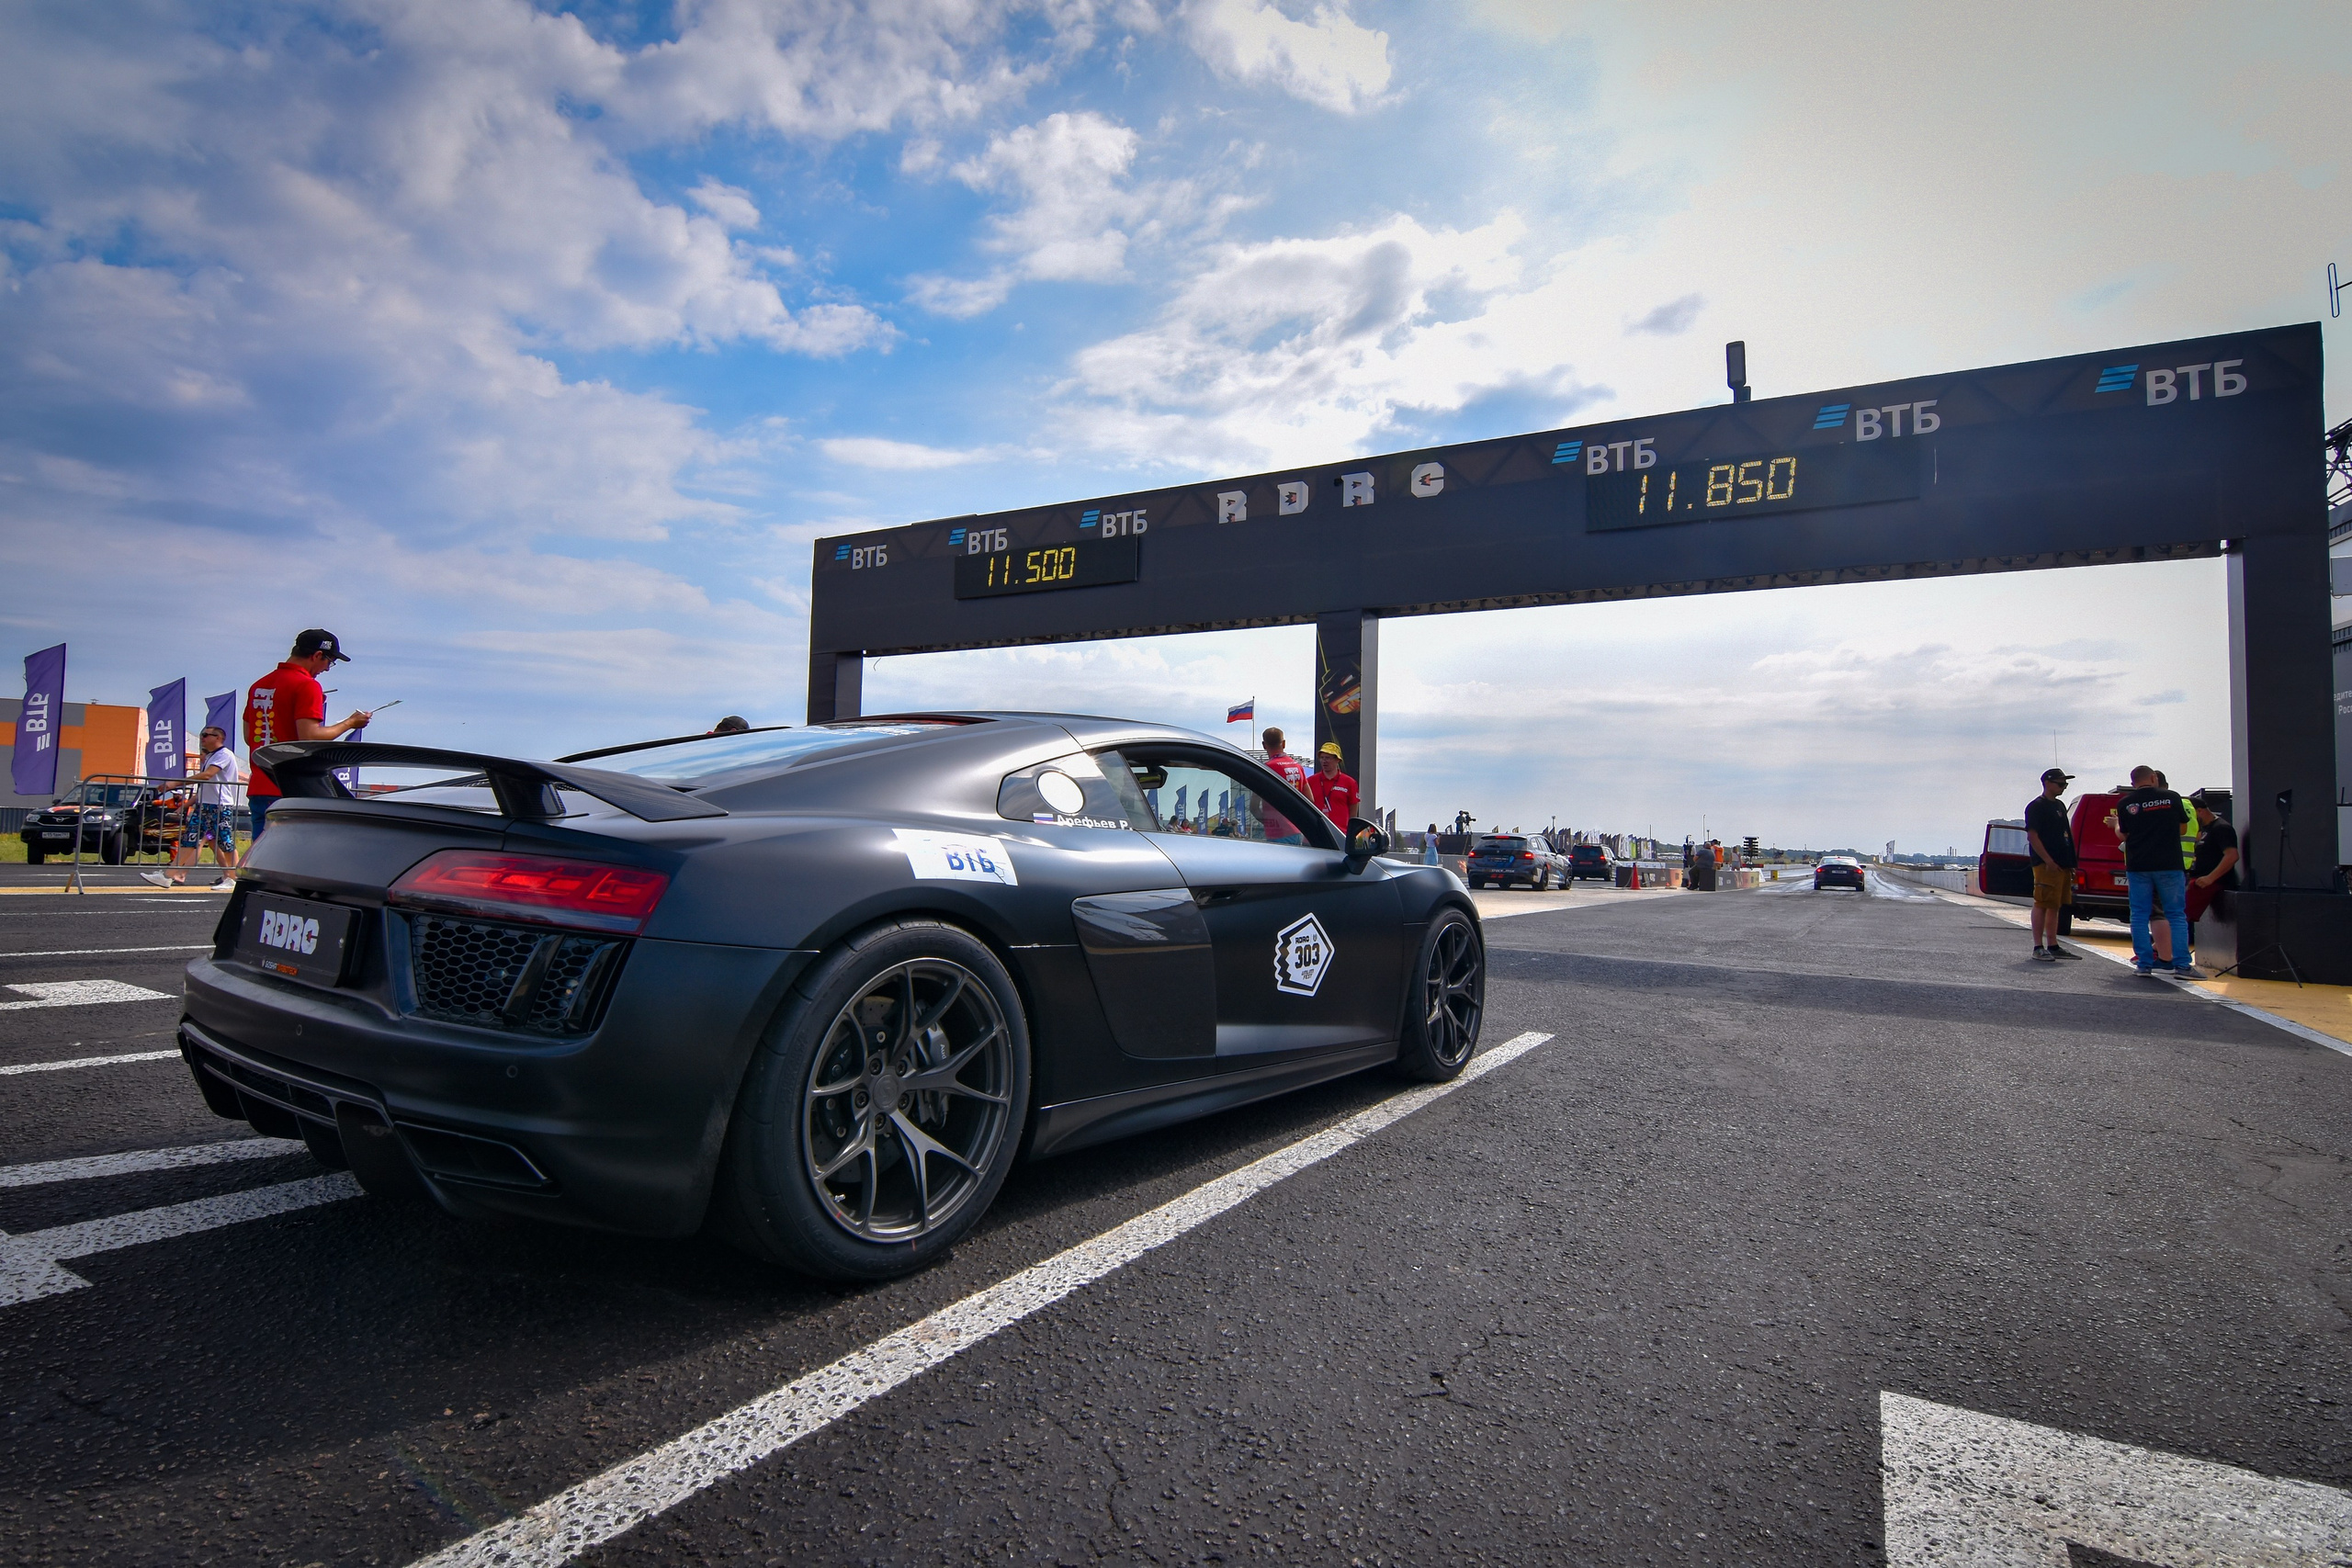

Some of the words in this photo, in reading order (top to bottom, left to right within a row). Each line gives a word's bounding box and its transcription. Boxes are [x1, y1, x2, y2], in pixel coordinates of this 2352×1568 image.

[2145, 358, 2247, 406] ВТБ
[1856, 400, 1940, 442] ВТБ
[1587, 438, 1657, 476] ВТБ
[1639, 457, 1796, 514] 11.850
[1102, 509, 1148, 538] ВТБ
[852, 545, 888, 570] ВТБ
[968, 528, 1008, 555] ВТБ
[988, 547, 1076, 587] 11.500
[2143, 799, 2171, 807] GOSHA
[1057, 814, 1116, 829] Арефьев
[260, 909, 320, 955] RDRC
[1295, 942, 1319, 969] 303
